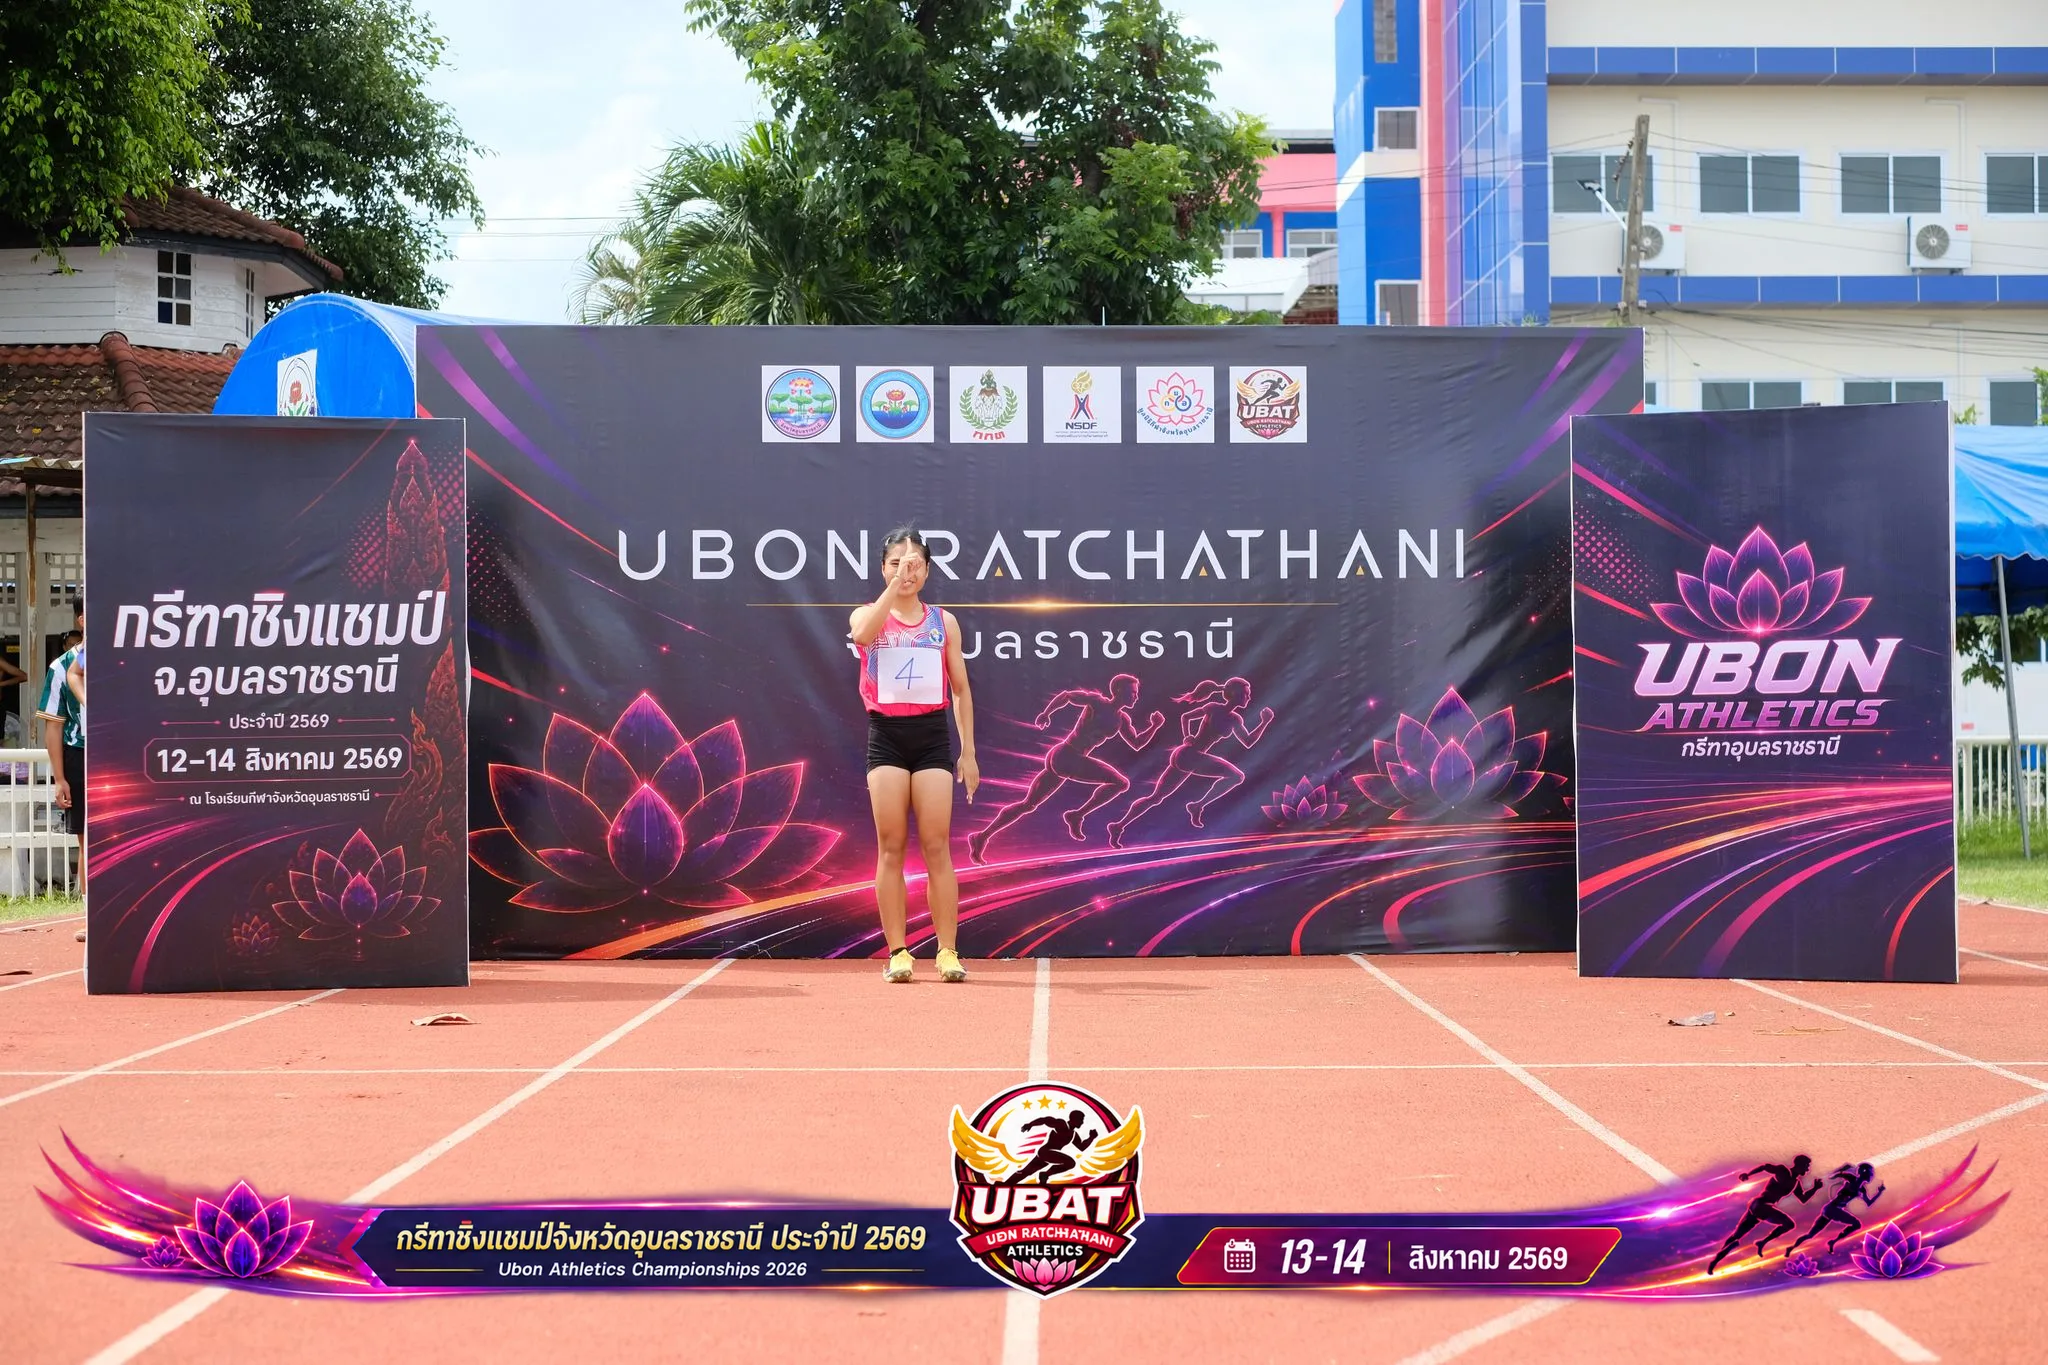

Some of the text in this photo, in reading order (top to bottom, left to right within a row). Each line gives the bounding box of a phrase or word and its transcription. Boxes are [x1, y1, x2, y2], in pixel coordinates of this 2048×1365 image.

[1065, 422, 1098, 430] NSDF
[1243, 405, 1295, 419] UBAT
[618, 528, 1464, 581] UBON RATCHATHANI
[113, 589, 447, 649] กรีฑาชิงแชมป์
[154, 653, 399, 707] จ.อุบลราชธานี
[894, 657, 924, 691] 4
[1634, 638, 1904, 697] UBON
[229, 712, 330, 730] ประจำปี 2569
[1640, 699, 1895, 730] ATHLETICS
[245, 747, 335, 772] สิงหาคม
[343, 747, 403, 770] 2569
[1681, 735, 1841, 762] กรีฑาอุบลราชธานี
